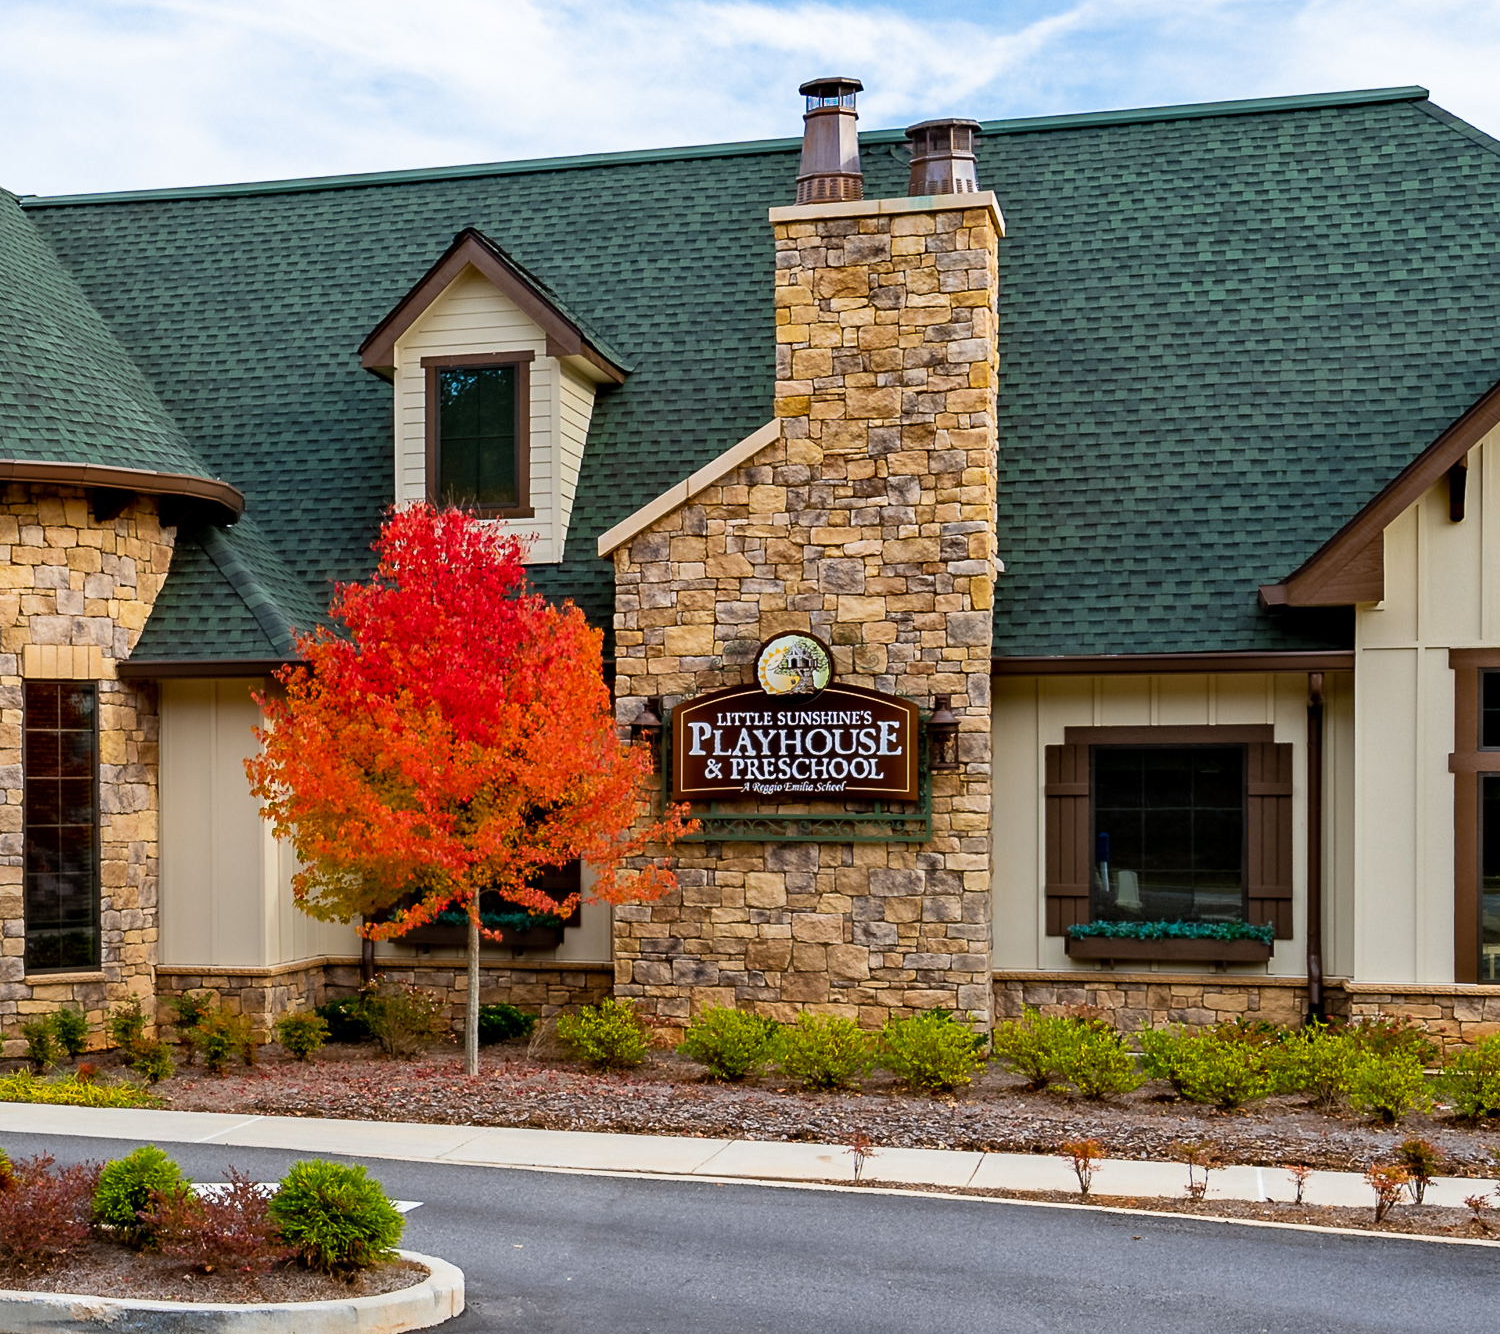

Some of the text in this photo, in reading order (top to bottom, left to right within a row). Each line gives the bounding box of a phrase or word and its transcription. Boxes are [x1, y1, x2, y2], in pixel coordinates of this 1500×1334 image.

[717, 711, 872, 725] LITTLE SUNSHINE'S
[687, 721, 902, 756] PLAYHOUSE
[704, 757, 884, 779] & PRESCHOOL
[740, 780, 847, 794] A Reggio Emilia School
